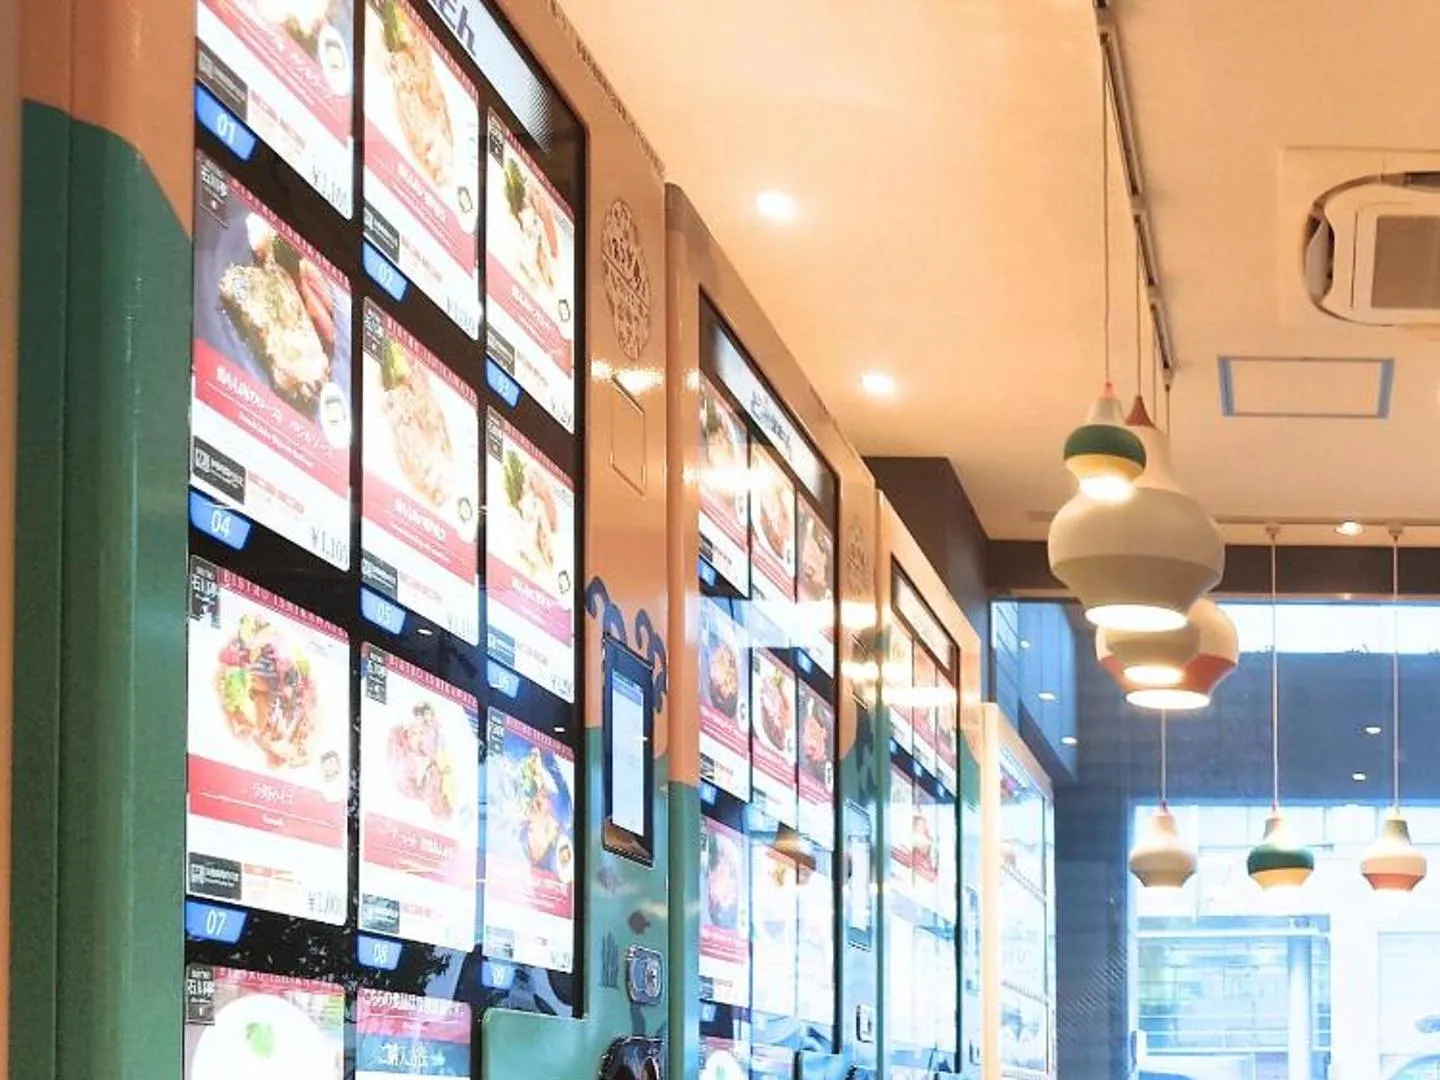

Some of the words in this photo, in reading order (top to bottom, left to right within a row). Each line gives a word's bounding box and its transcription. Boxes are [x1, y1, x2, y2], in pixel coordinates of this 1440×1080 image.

[215, 112, 237, 144] 01
[209, 509, 231, 537] 04
[206, 908, 228, 937] 07
